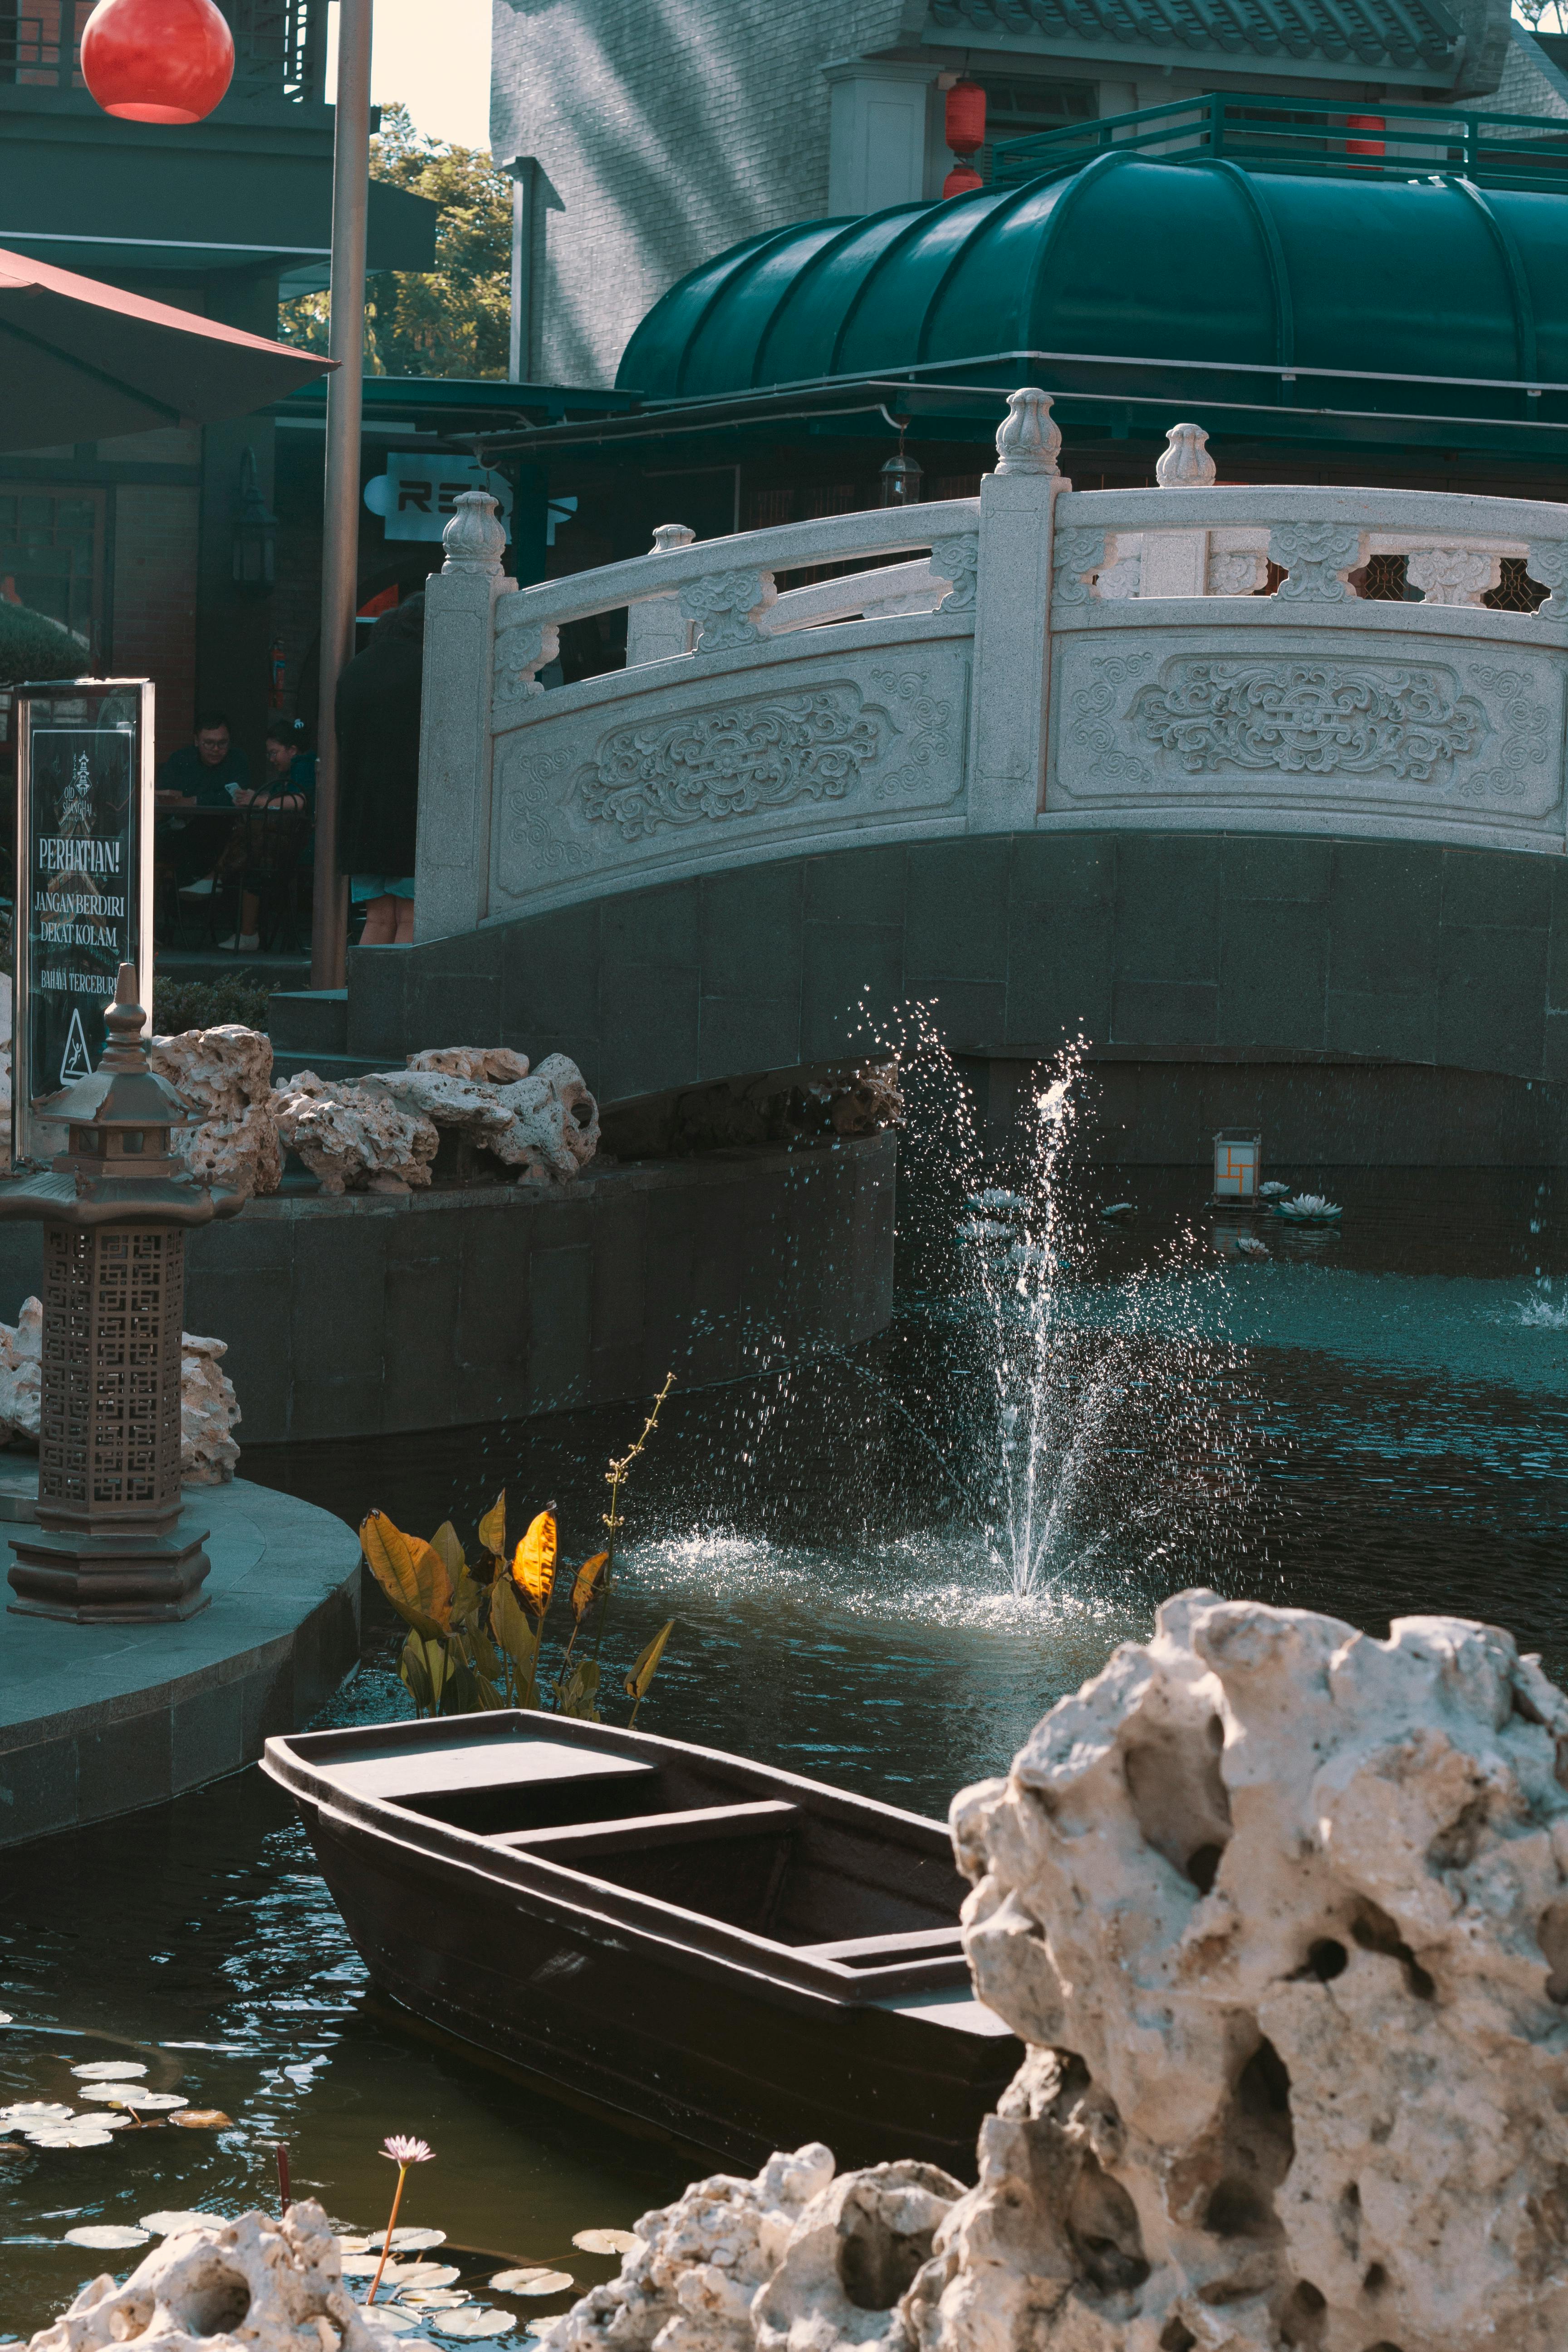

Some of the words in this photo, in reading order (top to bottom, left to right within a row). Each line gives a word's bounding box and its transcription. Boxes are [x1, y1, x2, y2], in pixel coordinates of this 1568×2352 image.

[64, 785, 74, 801] OLD
[63, 800, 92, 817] SHANGHAI
[39, 838, 120, 873] PERHATIAN!
[35, 891, 74, 913] JANGAN
[76, 894, 124, 916] BERDIRI
[41, 921, 74, 943] DEKAT
[75, 924, 117, 947] KOLAM
[41, 970, 67, 990] BAHAYA
